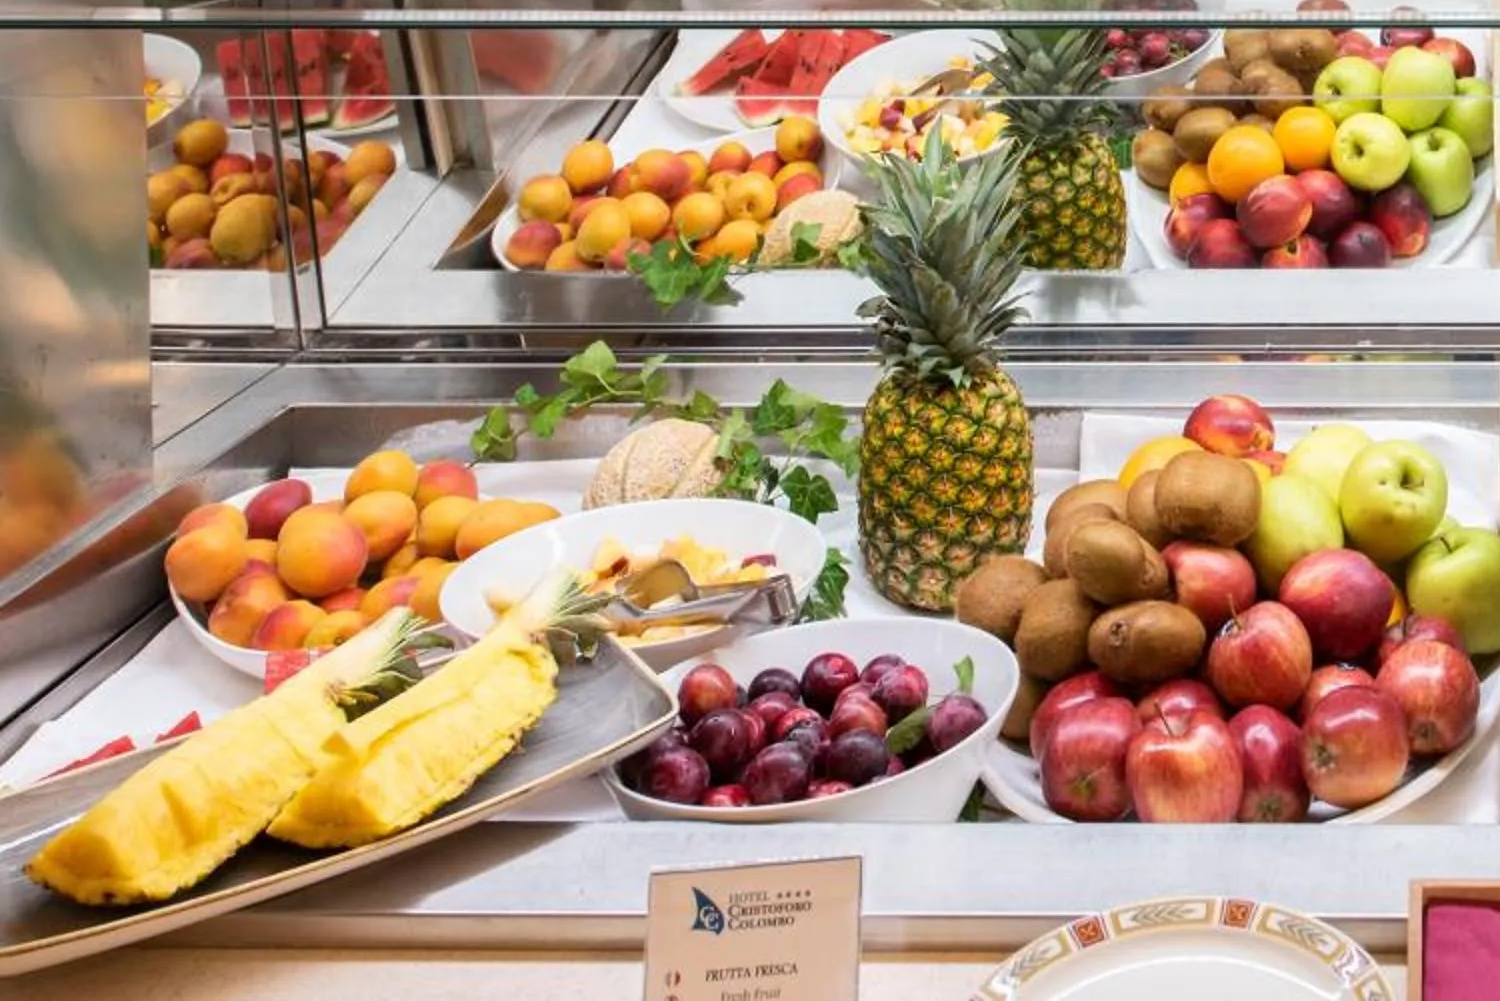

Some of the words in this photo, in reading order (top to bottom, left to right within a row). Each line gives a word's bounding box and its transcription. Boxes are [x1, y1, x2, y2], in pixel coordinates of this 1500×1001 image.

[728, 891, 769, 904] HOTEL
[727, 900, 813, 919] CRISTOFORO
[727, 916, 795, 931] COLOMBO
[704, 966, 752, 983] FRUTTA
[754, 961, 799, 978] FRESCA
